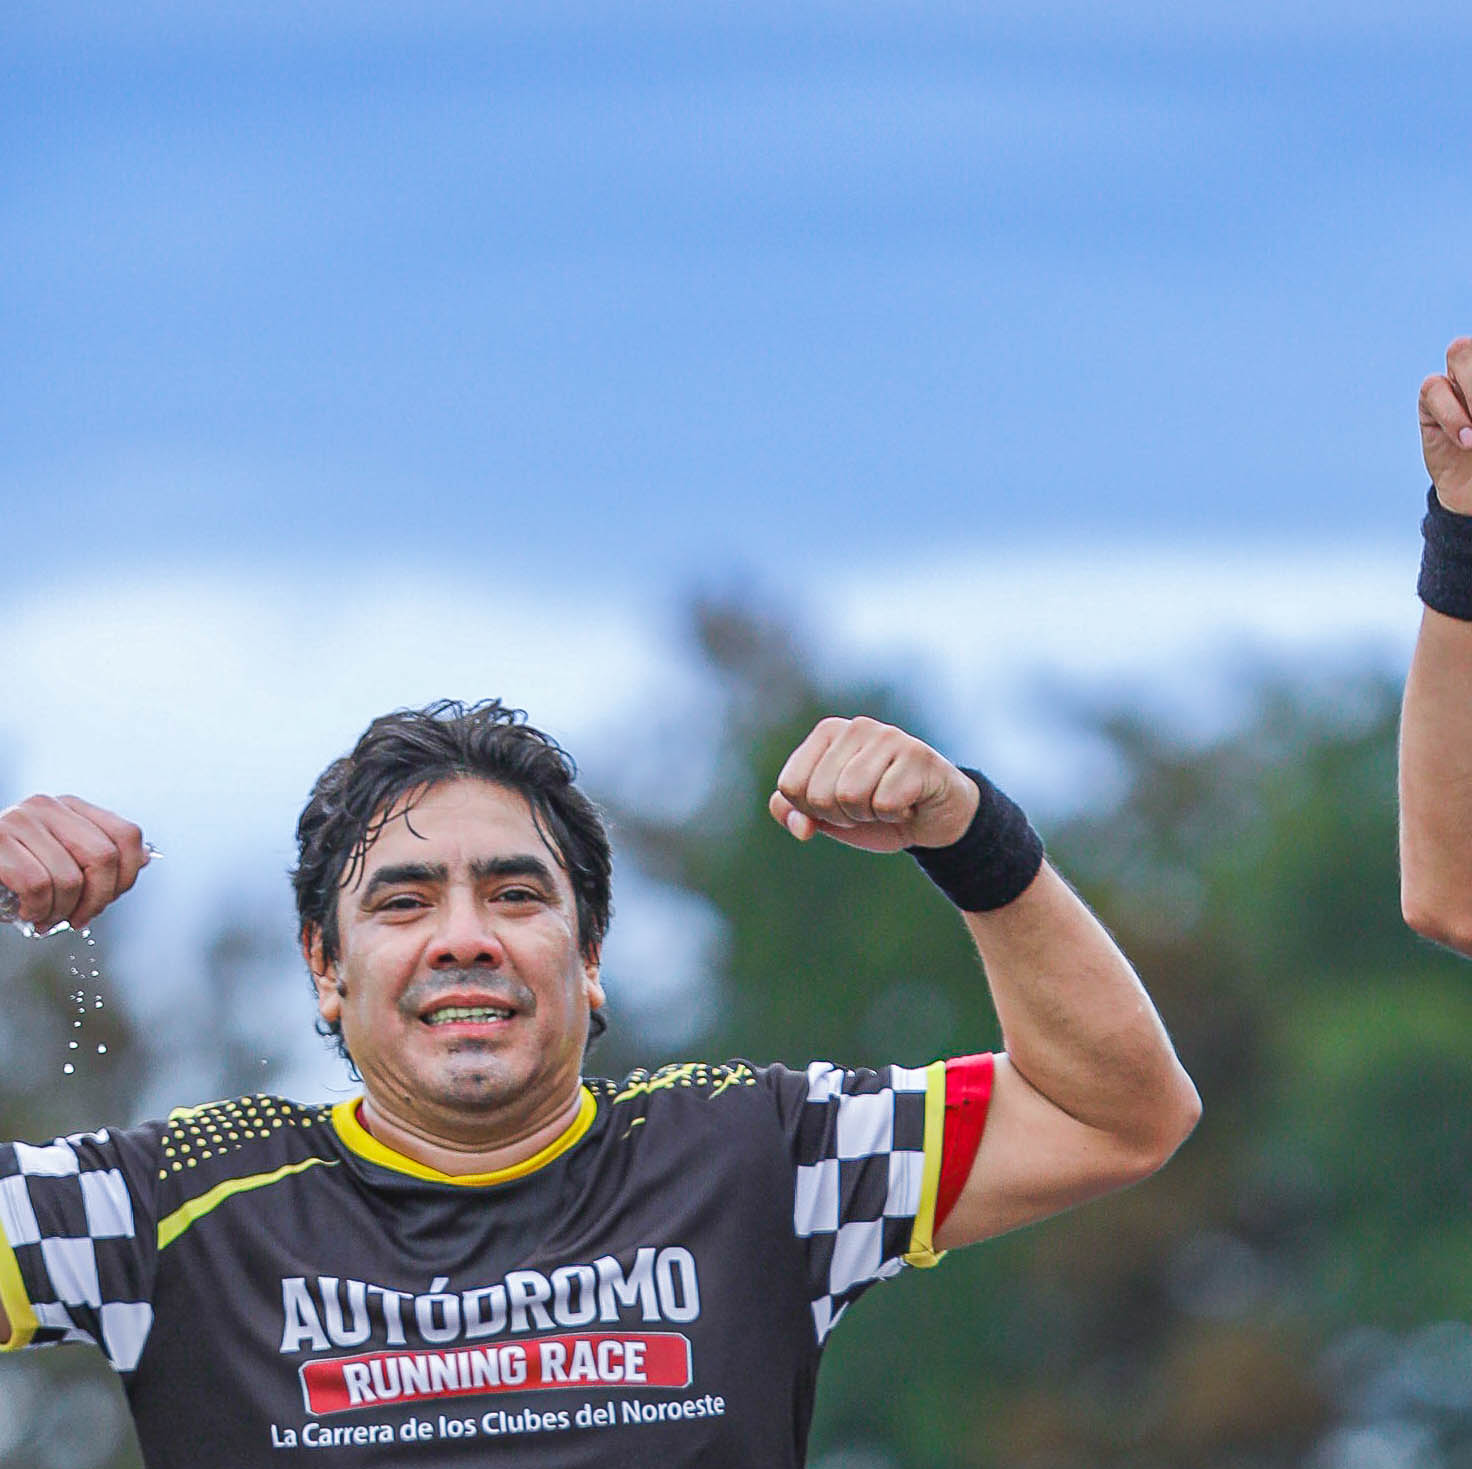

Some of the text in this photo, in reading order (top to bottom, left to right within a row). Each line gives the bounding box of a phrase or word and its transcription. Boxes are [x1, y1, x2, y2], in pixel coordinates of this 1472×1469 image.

[279, 1246, 700, 1353] AUTÓDROMO
[343, 1340, 647, 1405] RUNNING RACE
[271, 1394, 725, 1448] La Carrera de los Clubes del Noroeste
